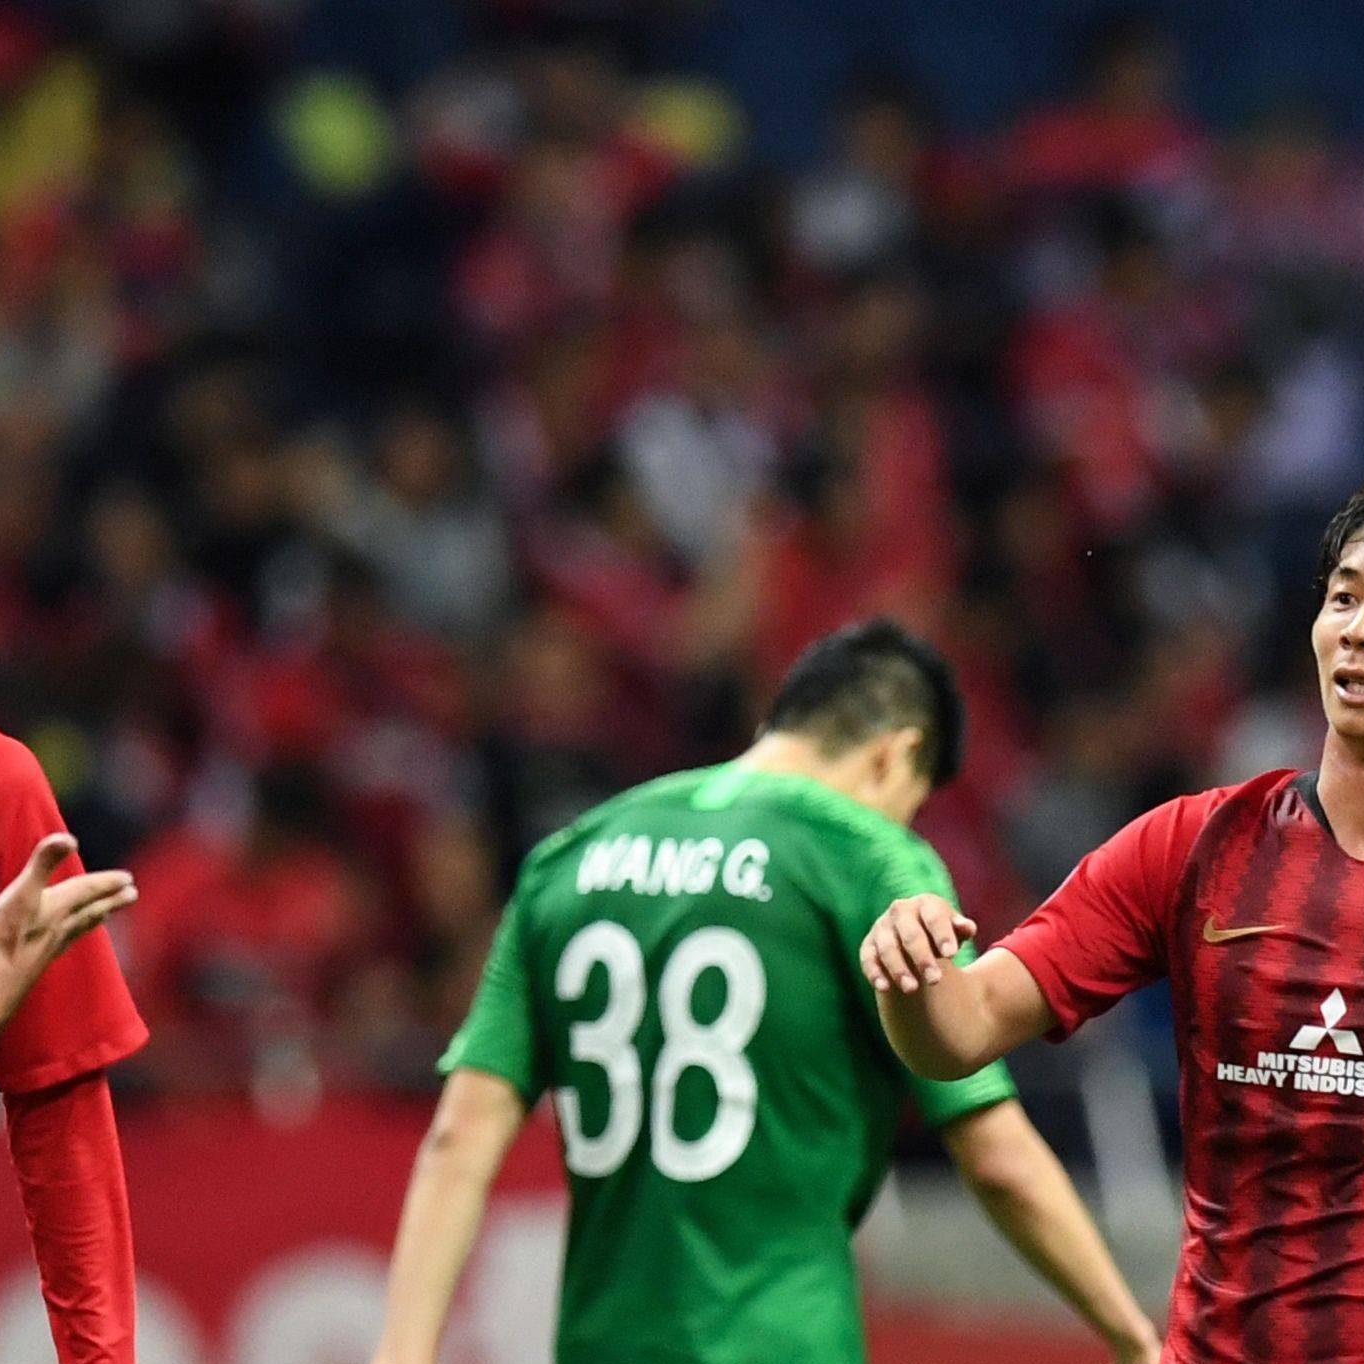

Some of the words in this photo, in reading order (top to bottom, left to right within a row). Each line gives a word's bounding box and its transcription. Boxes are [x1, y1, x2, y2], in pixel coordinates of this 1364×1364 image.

[576, 833, 724, 897] WANG
[554, 919, 767, 1183] 38
[1216, 1062, 1288, 1088] HEAVY
